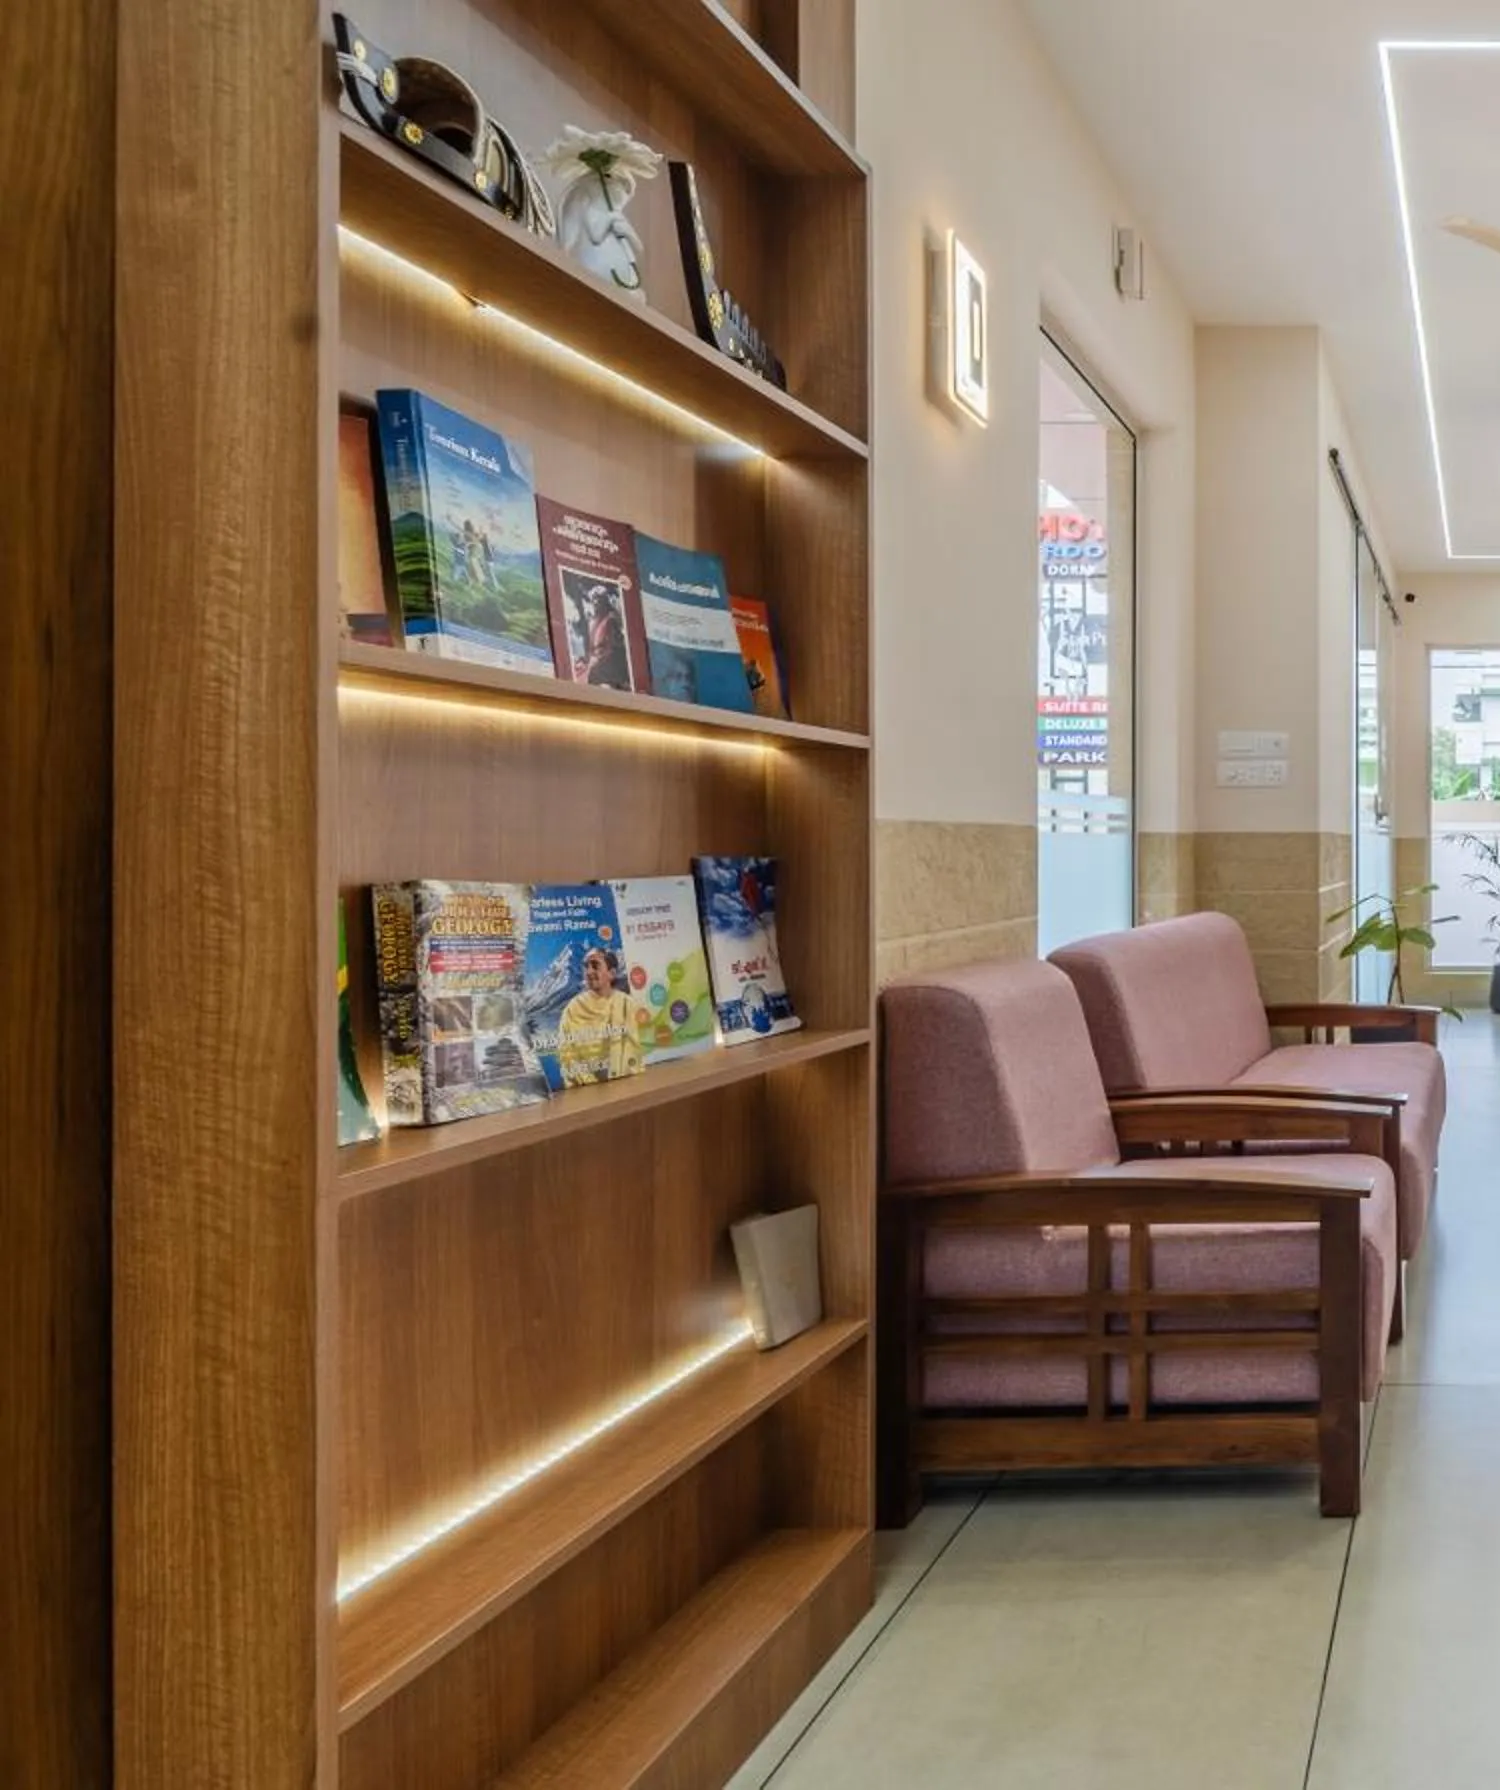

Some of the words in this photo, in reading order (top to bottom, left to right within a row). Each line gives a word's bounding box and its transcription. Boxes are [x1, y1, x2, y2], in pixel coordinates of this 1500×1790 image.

[1045, 701, 1089, 713] SUITE
[1045, 718, 1097, 730] DELUXE
[1045, 735, 1107, 747] STANDARD
[1043, 751, 1105, 763] PARK
[566, 895, 603, 909] Living
[431, 917, 513, 937] GEOLOGY
[564, 919, 597, 931] Rama
